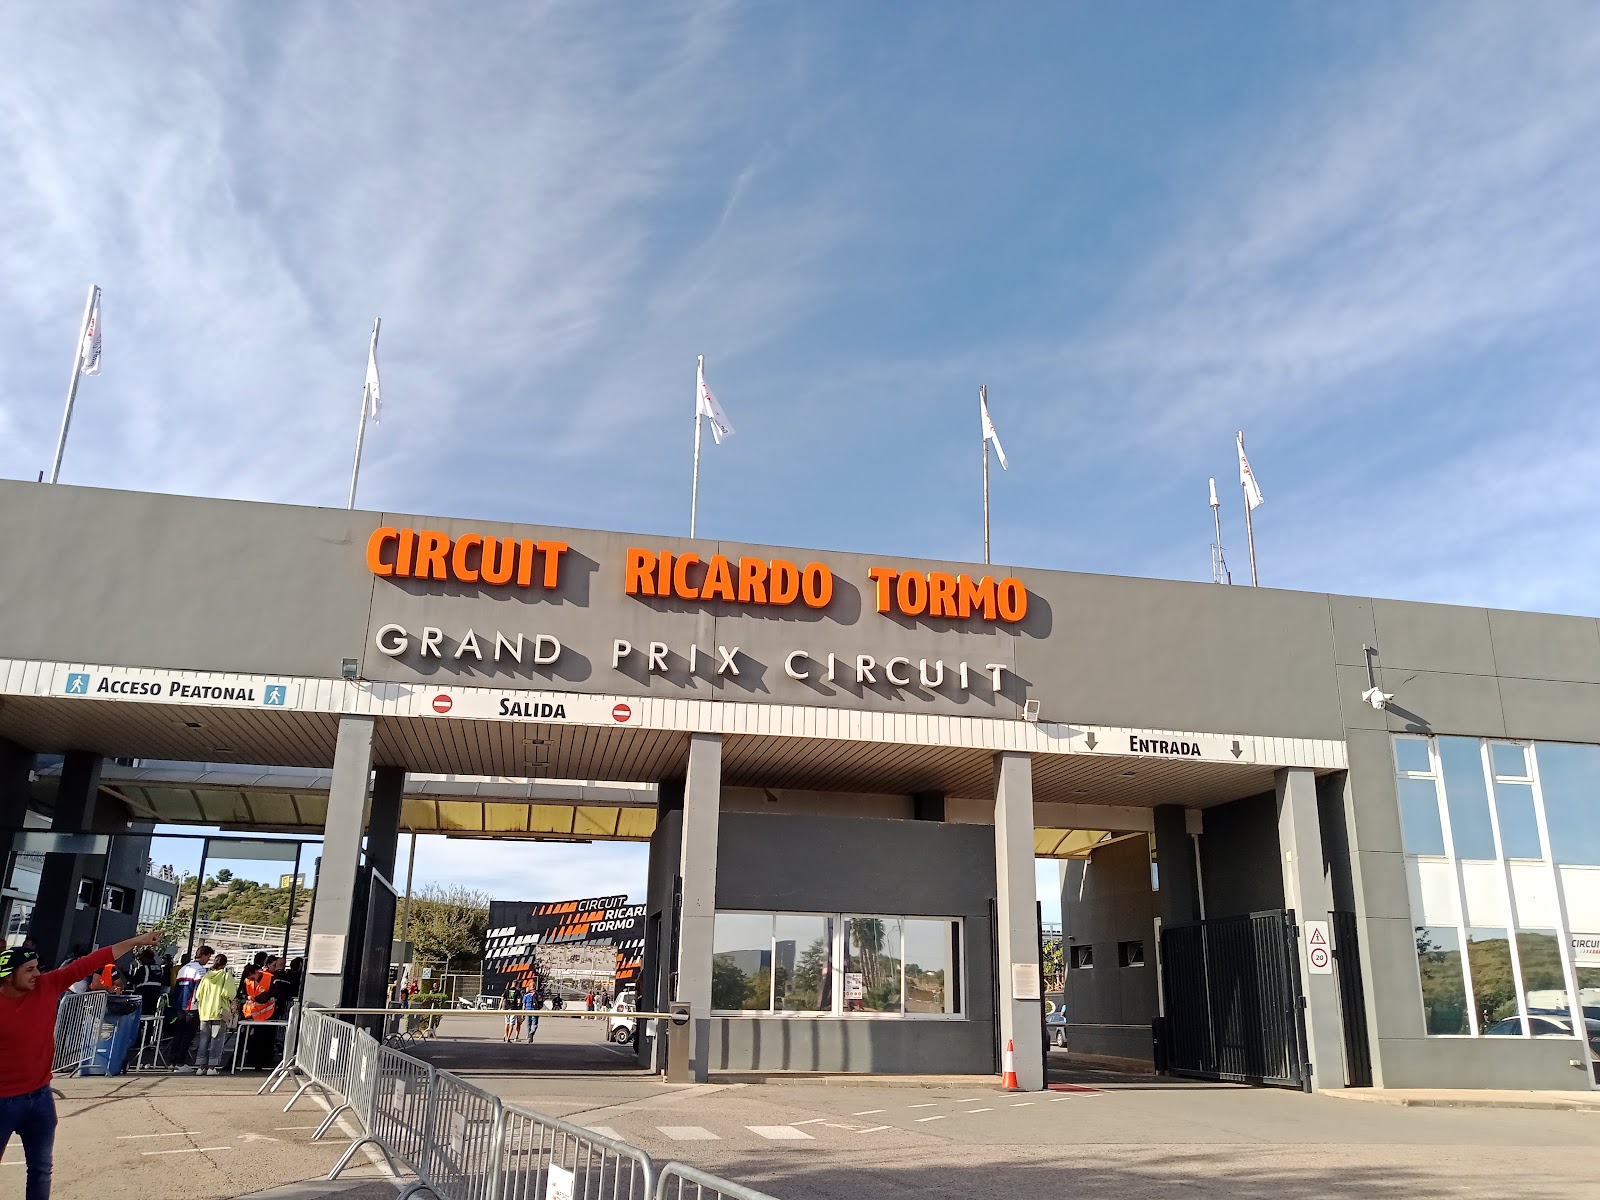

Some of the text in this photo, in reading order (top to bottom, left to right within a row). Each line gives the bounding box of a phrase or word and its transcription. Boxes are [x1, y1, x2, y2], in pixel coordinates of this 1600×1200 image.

[366, 526, 1028, 623] CIRCUIT RICARDO TORMO
[375, 623, 1007, 692] GRAND PRIX CIRCUIT
[97, 677, 256, 701] ACCESO PEATONAL
[499, 697, 567, 719] SALIDA
[1129, 735, 1202, 756] ENTRADA
[578, 896, 626, 912] CIRCUIT
[591, 918, 635, 933] TORMO
